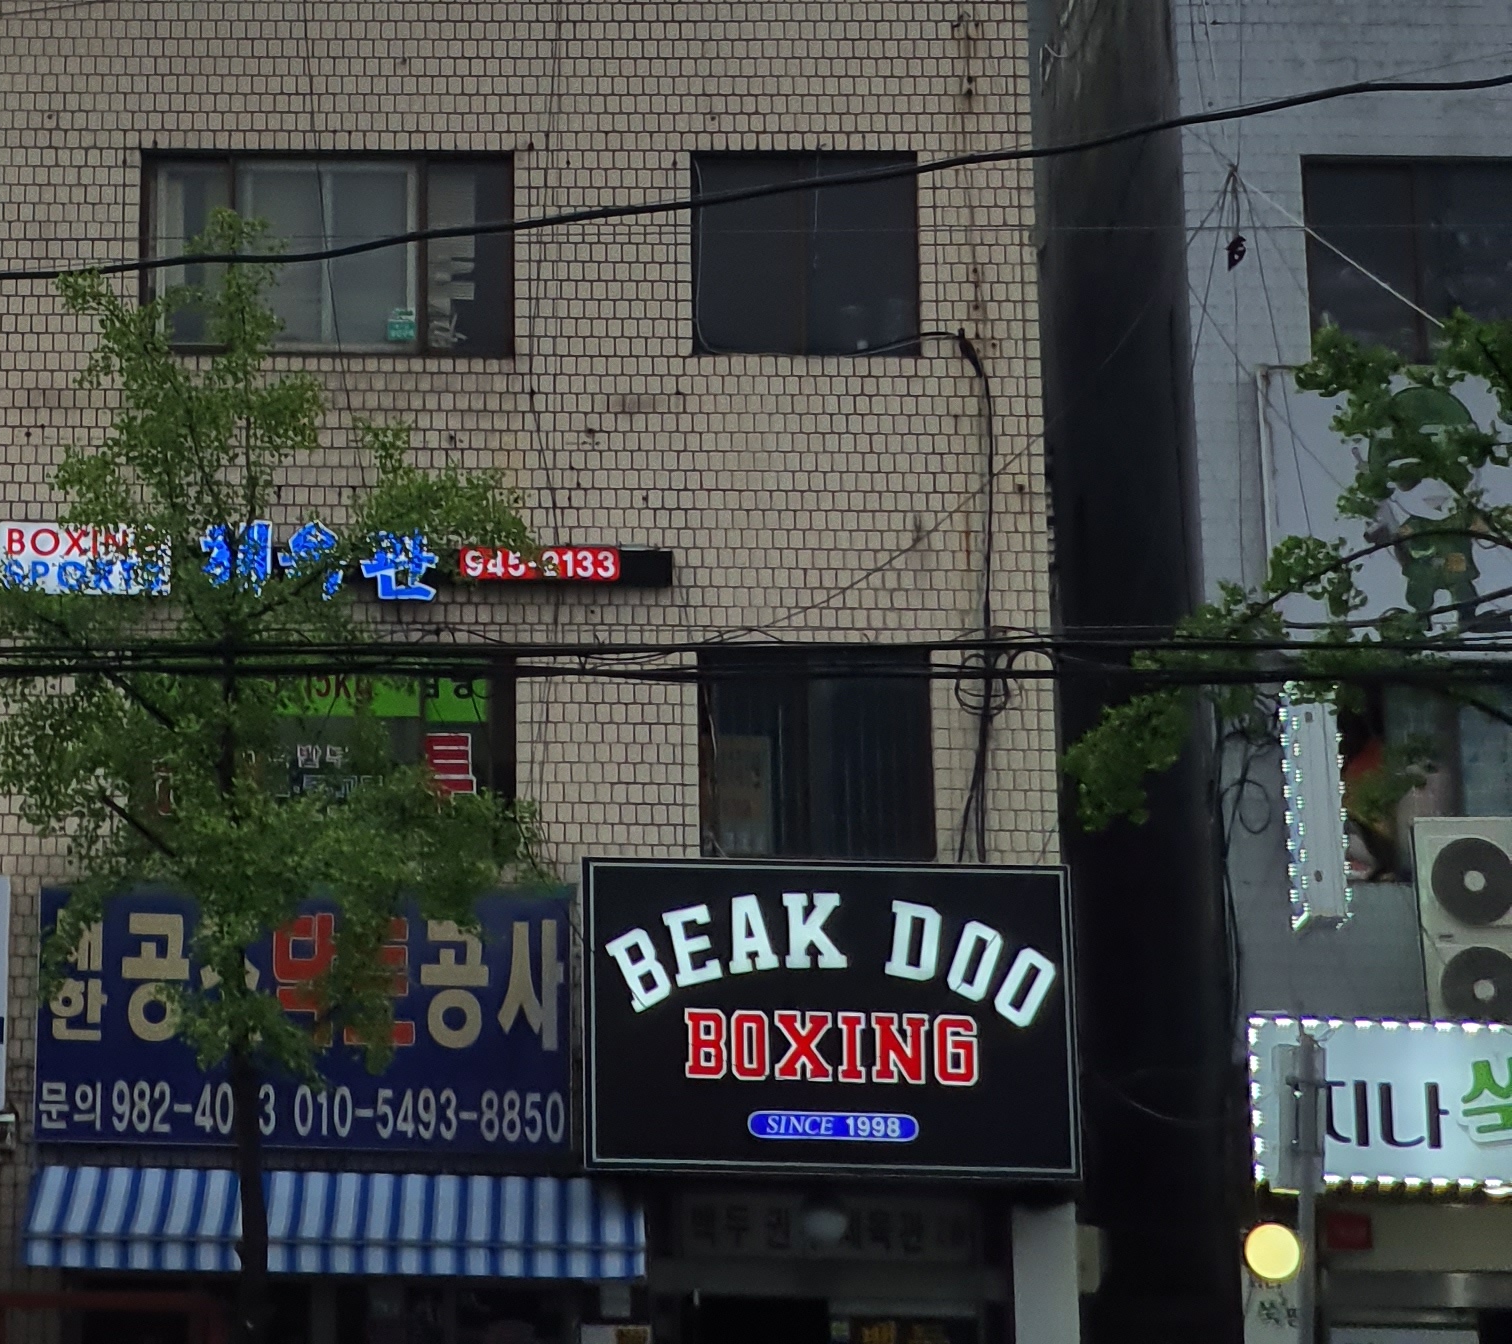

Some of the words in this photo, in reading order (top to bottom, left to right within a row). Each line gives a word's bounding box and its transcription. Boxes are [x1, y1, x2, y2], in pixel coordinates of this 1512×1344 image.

[605, 892, 848, 1013] BEAK
[885, 900, 1056, 1028] DOO
[684, 1008, 979, 1087] BOXING
[39, 1082, 102, 1131] 문의
[112, 1080, 277, 1136] 982-403
[294, 1084, 566, 1144] 010-5493-8850
[767, 1115, 834, 1135] SINCE
[846, 1115, 901, 1137] 1998
